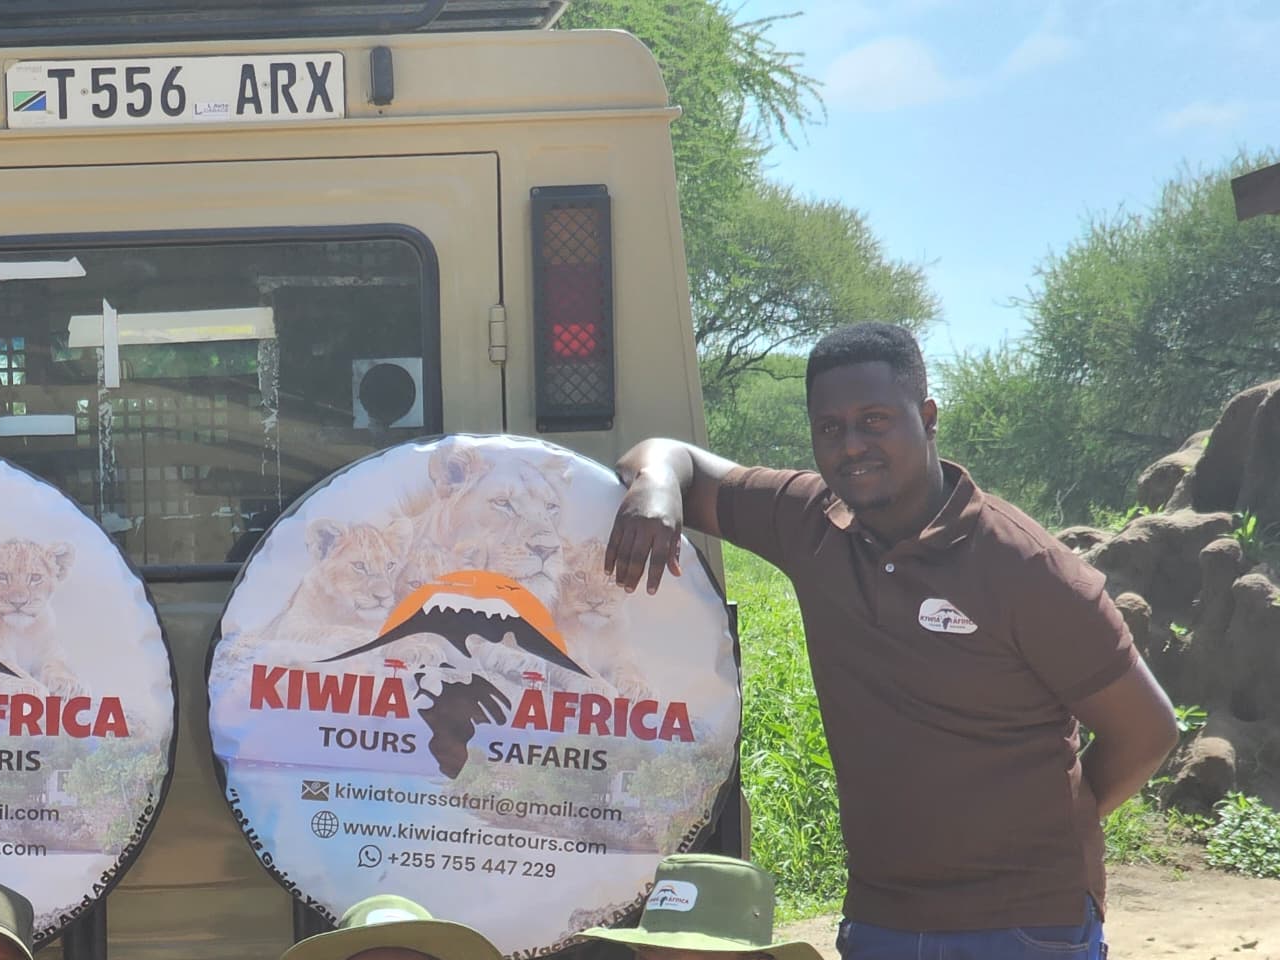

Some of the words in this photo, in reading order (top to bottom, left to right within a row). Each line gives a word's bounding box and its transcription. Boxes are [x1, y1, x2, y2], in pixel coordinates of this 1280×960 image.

[236, 61, 334, 115] ARX
[250, 664, 410, 719] KIWIA
[511, 688, 696, 742] AFRICA
[319, 726, 417, 754] TOURS
[488, 741, 608, 771] SAFARIS
[335, 783, 623, 822] kiwiatourssafari@gmail.com
[343, 822, 608, 855] www.kiwiaafricatours.com
[387, 851, 436, 869] +255
[441, 854, 476, 872] 755
[481, 858, 518, 876] 447
[521, 861, 556, 879] 229
[59, 894, 92, 927] And
